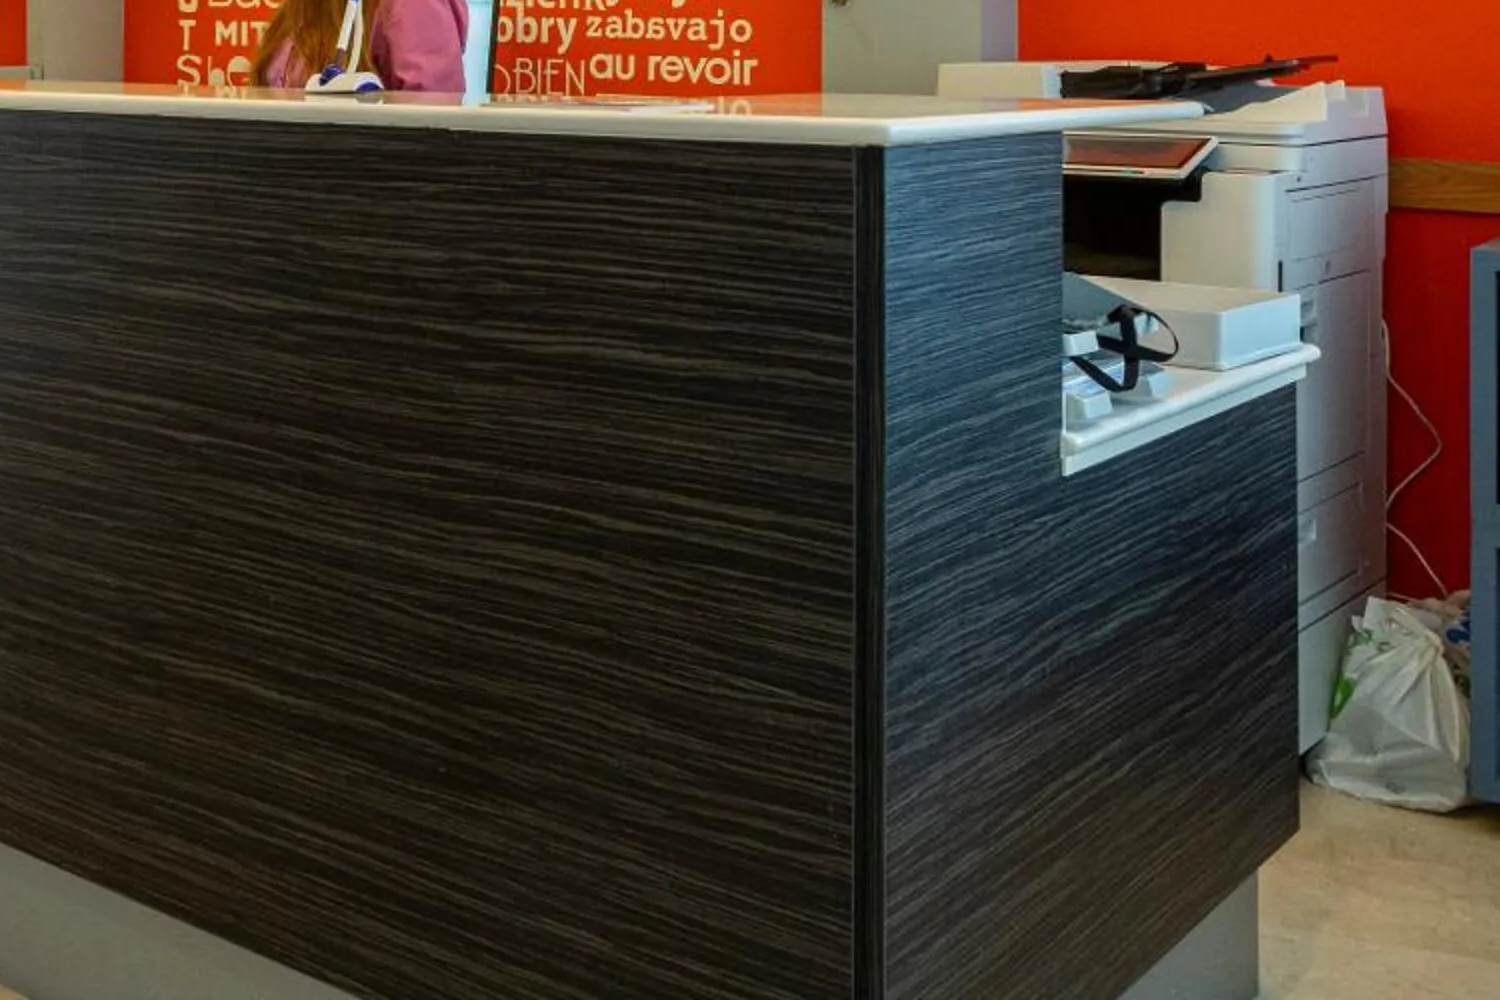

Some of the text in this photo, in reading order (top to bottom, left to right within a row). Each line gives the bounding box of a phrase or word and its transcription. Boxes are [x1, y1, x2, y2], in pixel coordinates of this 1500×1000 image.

[496, 0, 578, 54] obry
[589, 50, 759, 86] au revoir
